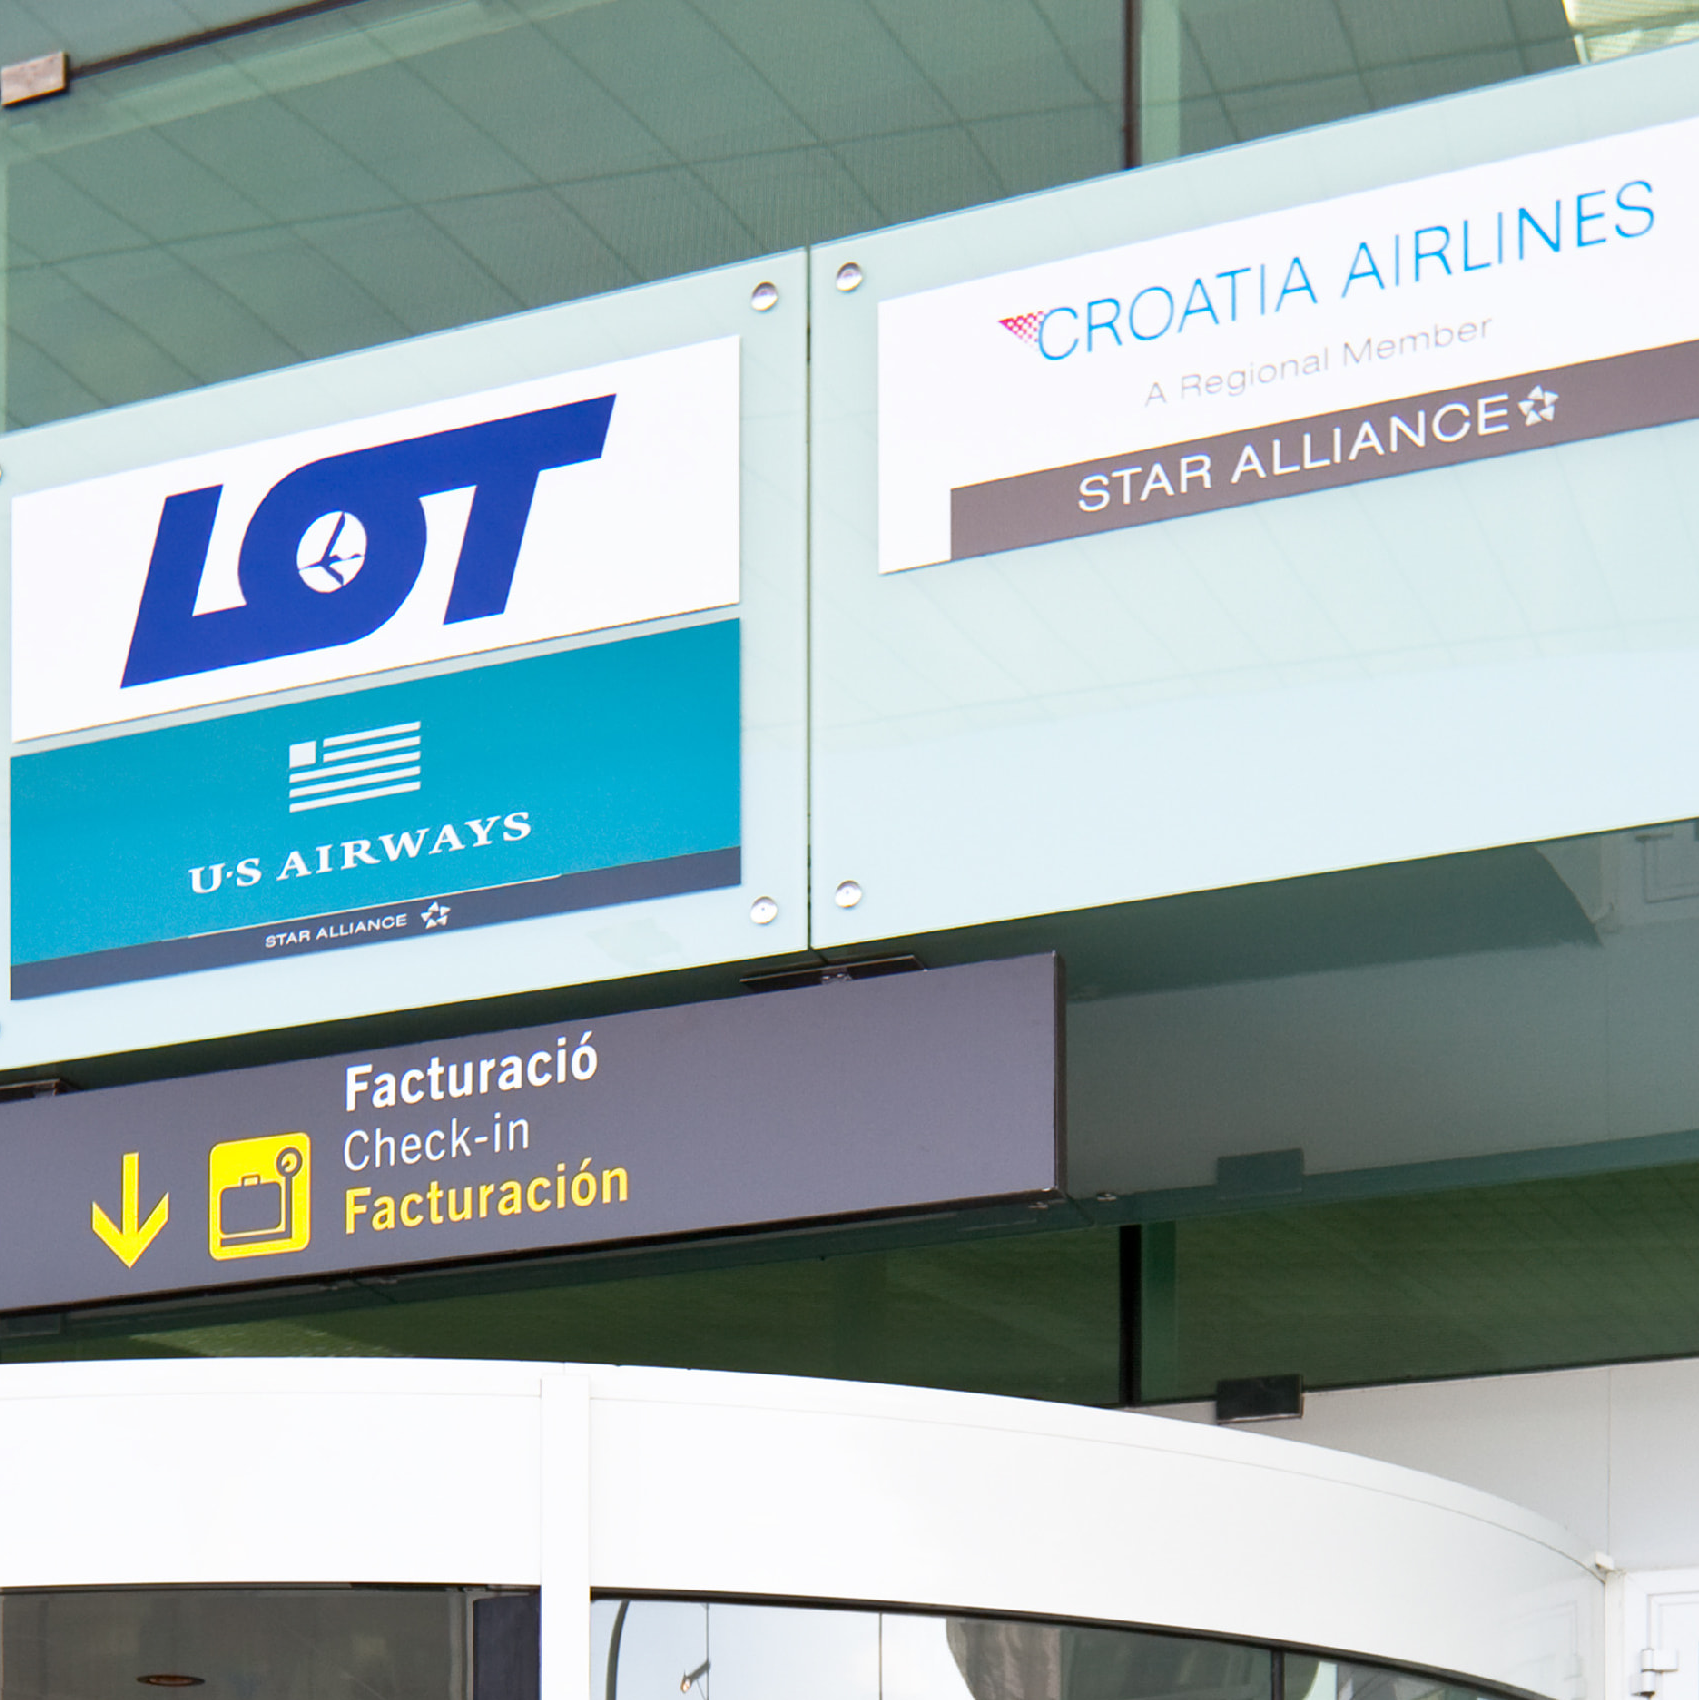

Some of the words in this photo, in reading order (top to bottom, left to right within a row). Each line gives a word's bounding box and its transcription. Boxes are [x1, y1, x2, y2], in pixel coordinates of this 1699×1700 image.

[1035, 257, 1319, 362] CROATIA
[1341, 179, 1656, 299] AIRLINES
[1144, 381, 1169, 407] A
[1181, 346, 1330, 402] Regional
[1342, 317, 1494, 366] Member
[1076, 453, 1214, 513] STAR
[1230, 393, 1510, 483] ALLIANCE
[119, 392, 617, 689] LOT
[276, 811, 532, 882] AIRWAYS
[265, 929, 311, 948] STAR
[315, 913, 408, 940] ALLIANCE
[344, 1030, 598, 1112] Facturació
[343, 1112, 530, 1172] Check-in
[344, 1157, 629, 1235] Facturación
